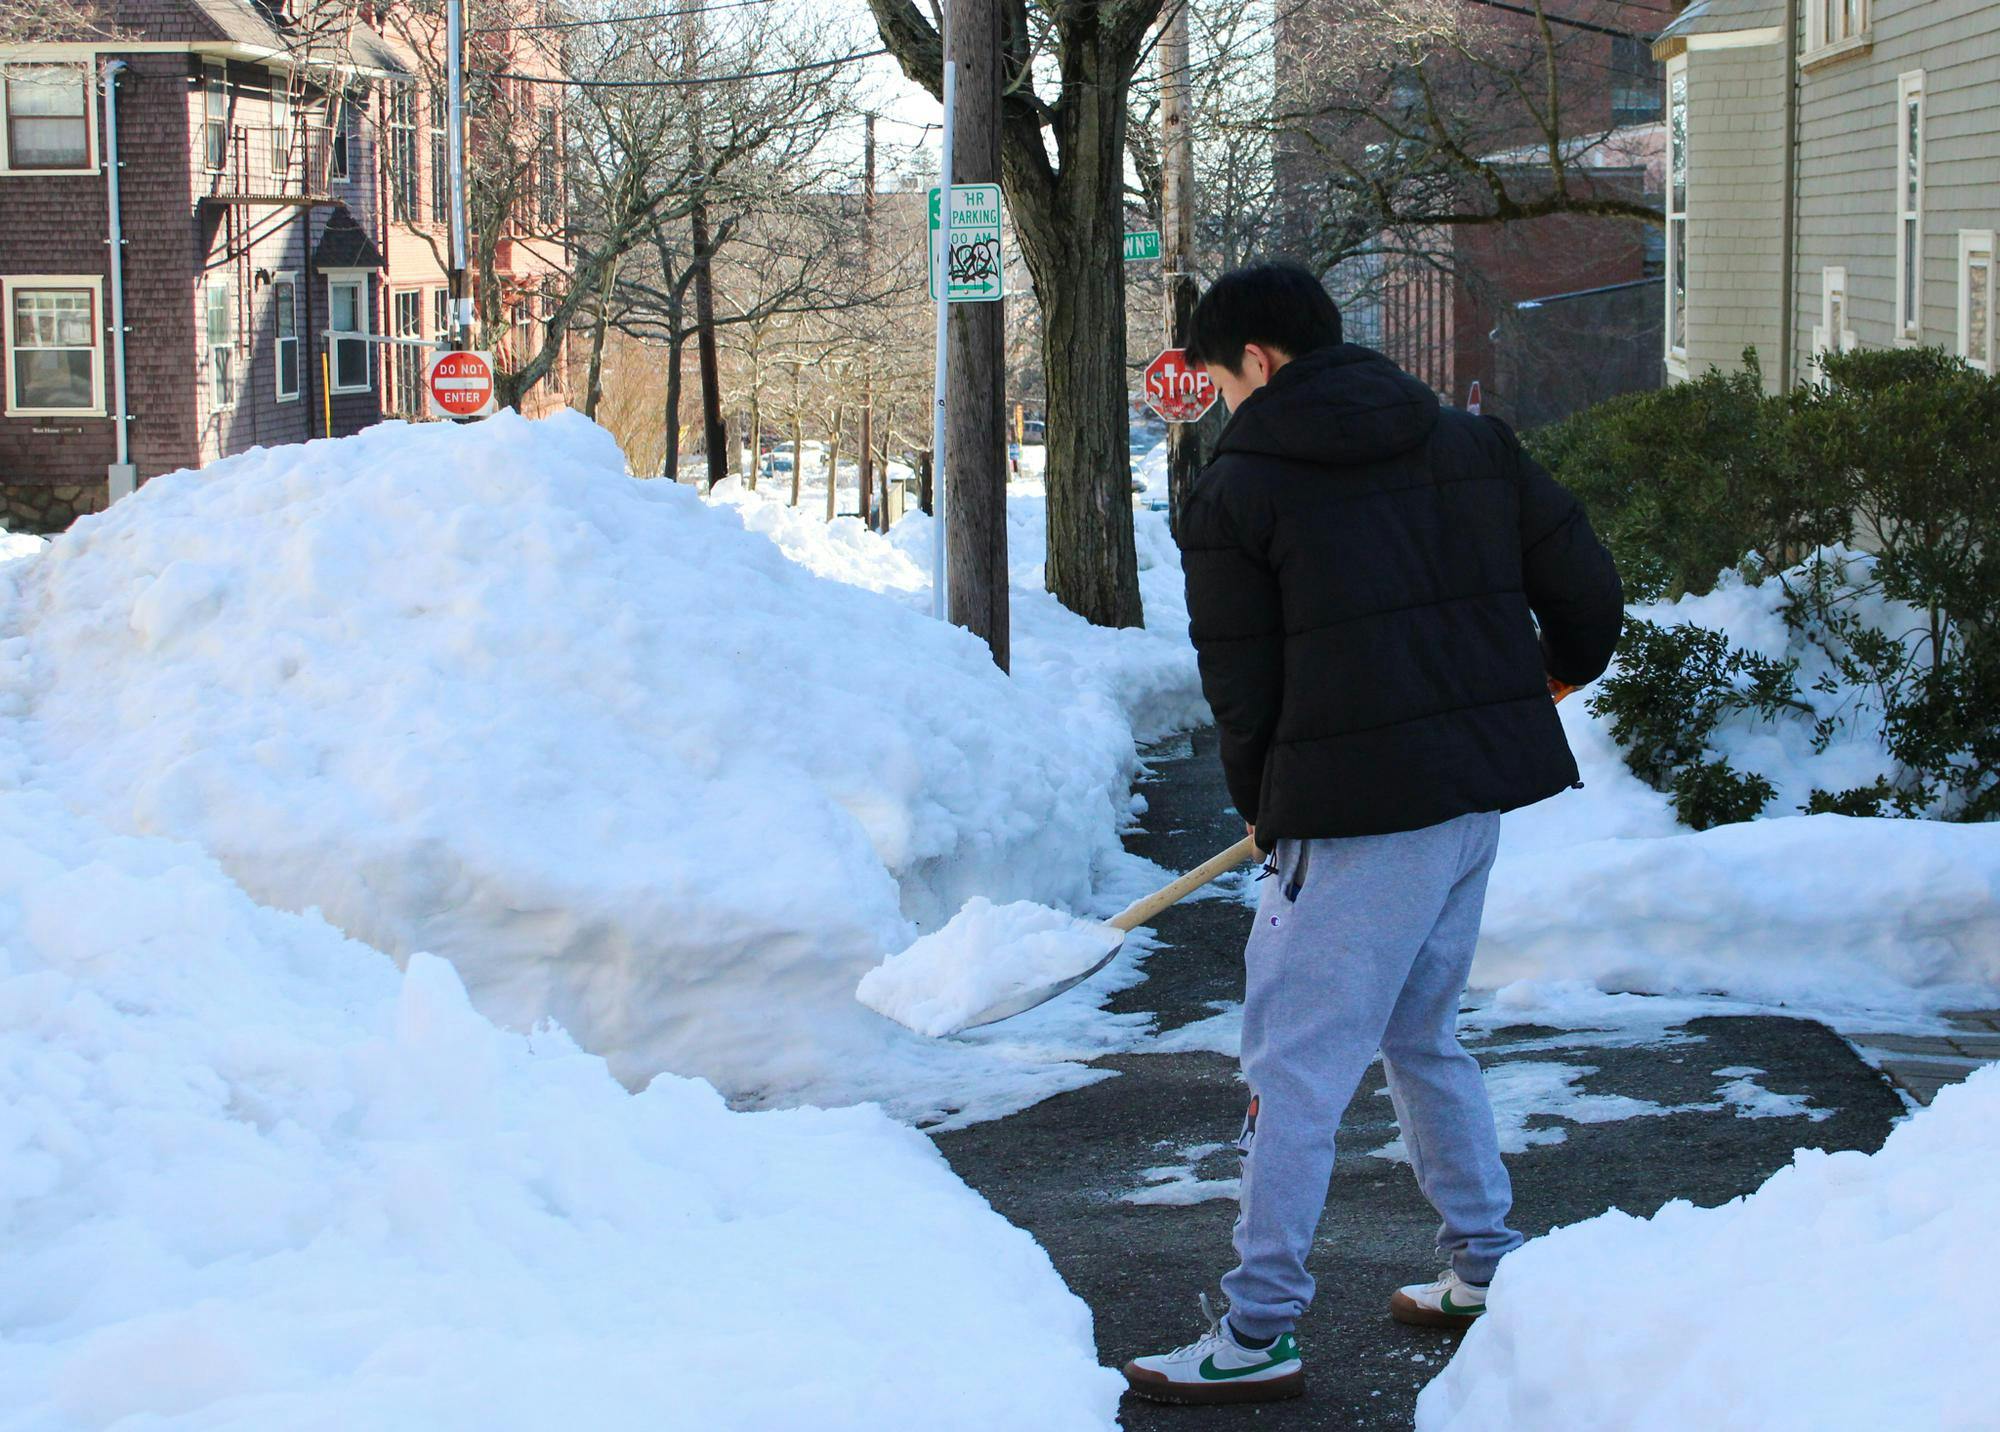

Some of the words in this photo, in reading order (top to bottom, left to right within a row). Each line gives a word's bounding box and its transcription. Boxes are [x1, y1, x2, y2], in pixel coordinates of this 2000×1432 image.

[965, 192, 984, 206] HR
[953, 210, 996, 224] PARKING
[975, 232, 991, 243] AM
[1123, 236, 1145, 256] WN
[440, 364, 455, 375] DO
[461, 364, 484, 375] NOT
[1150, 371, 1210, 399] STOP
[444, 392, 480, 403] ENTER
